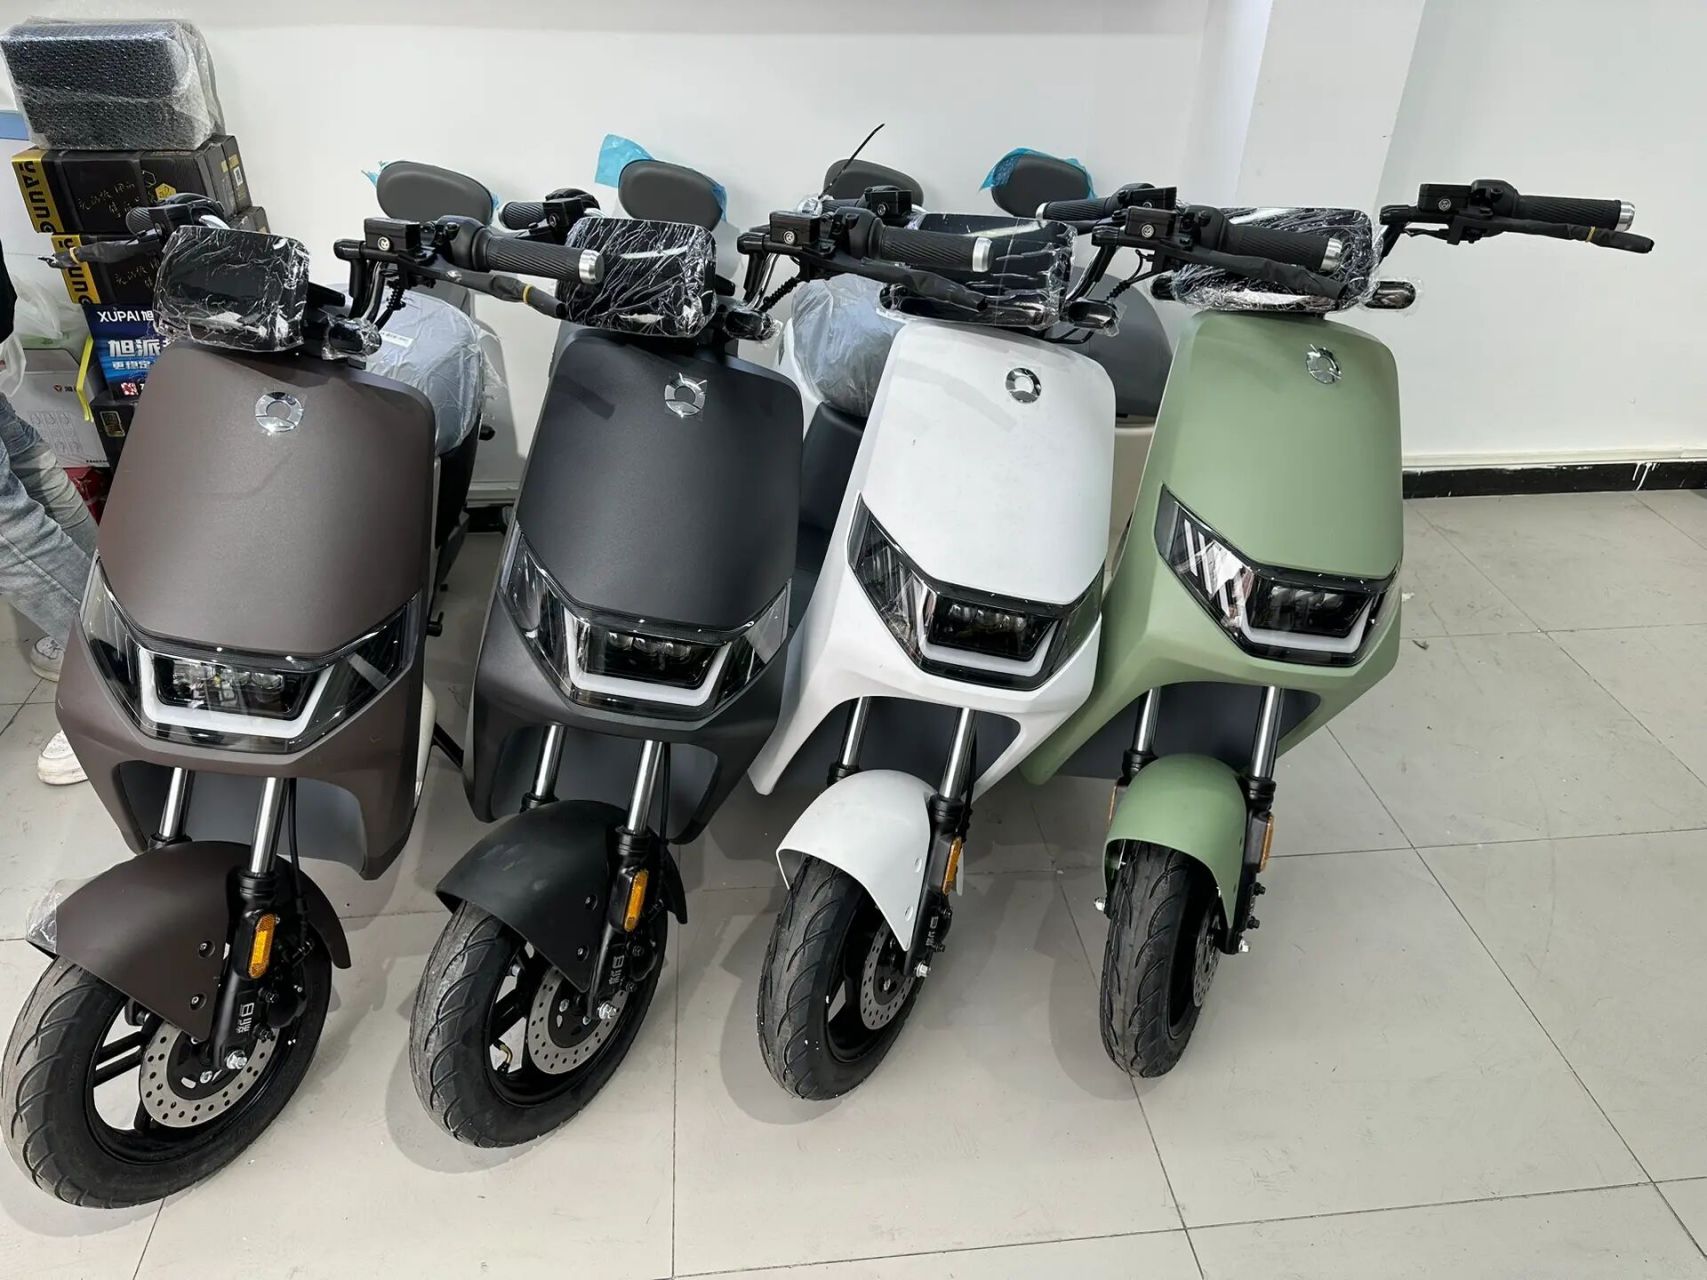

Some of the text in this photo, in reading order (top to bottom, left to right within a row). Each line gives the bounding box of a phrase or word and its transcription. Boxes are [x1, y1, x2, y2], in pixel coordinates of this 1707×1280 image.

[97, 310, 140, 322] XUPAI
[107, 339, 169, 357] 旭派
[236, 1002, 255, 1034] 新日
